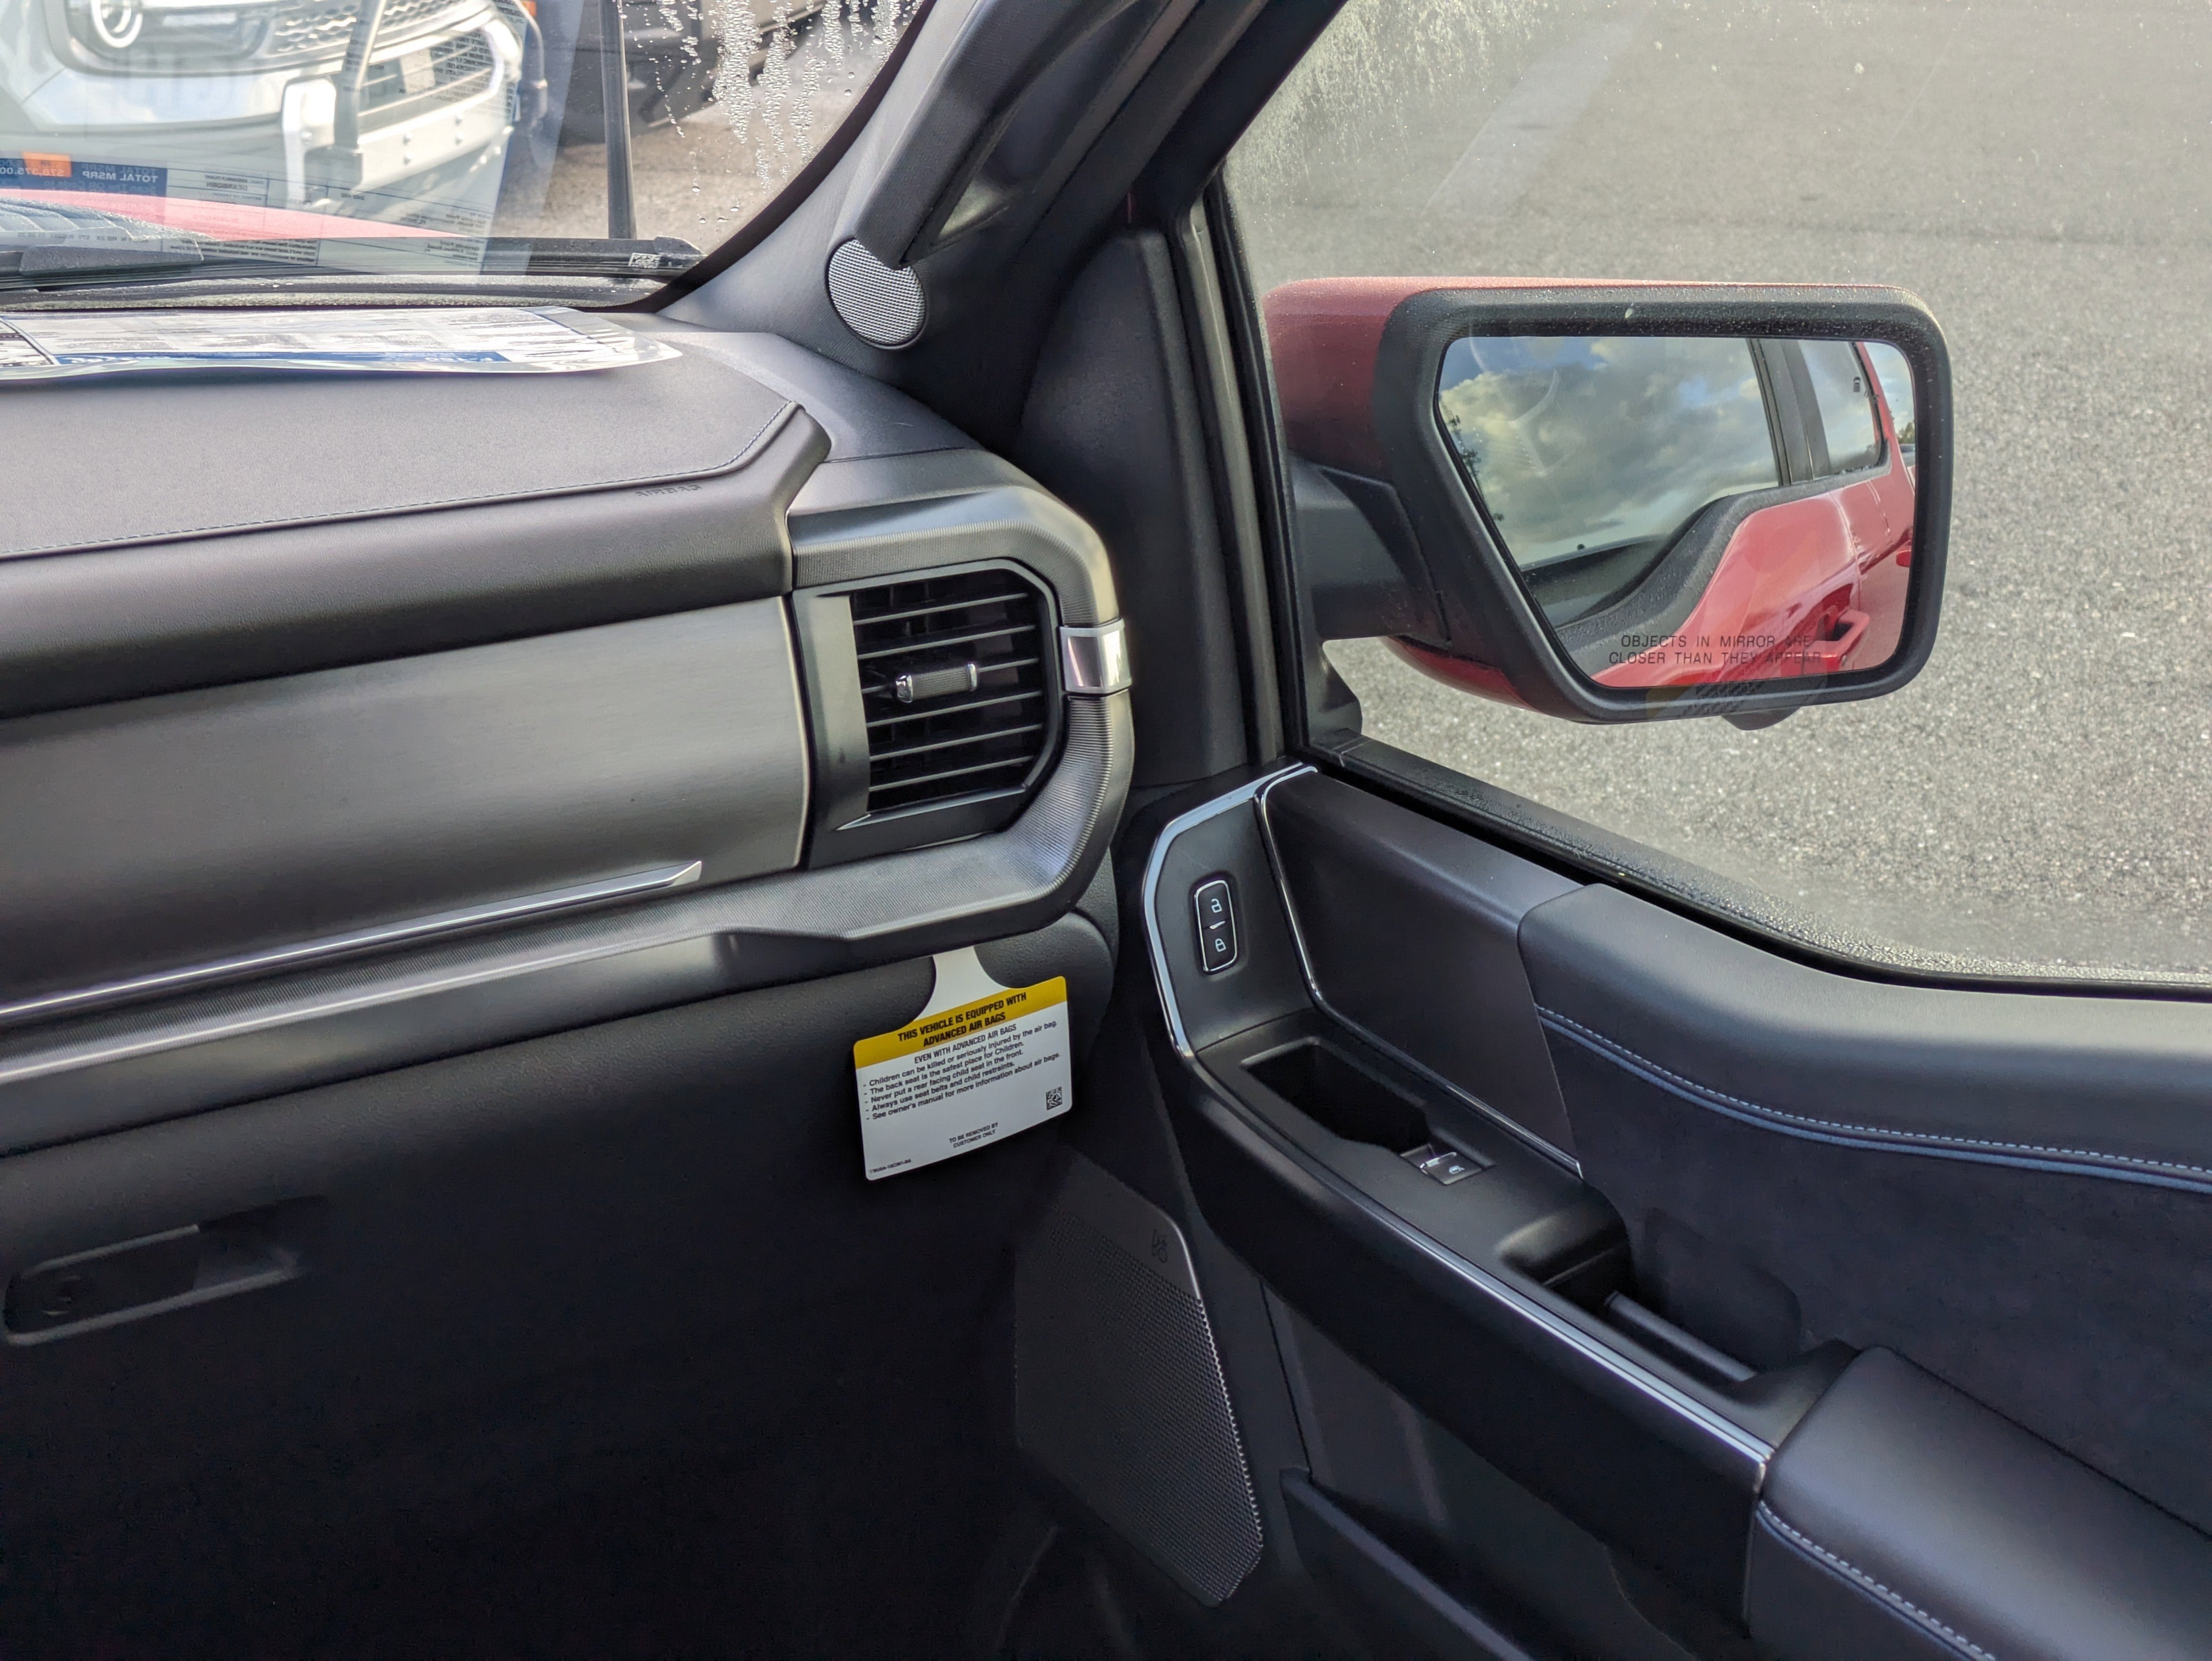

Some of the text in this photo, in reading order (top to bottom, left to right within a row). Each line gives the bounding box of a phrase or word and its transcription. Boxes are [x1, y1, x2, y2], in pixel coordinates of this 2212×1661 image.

[636, 485, 702, 496] AIRBAG
[1609, 651, 1821, 664] CLOSER THAN THEY APPEAR
[1621, 635, 1811, 647] OBJECTS IN MIRROR ARE
[897, 993, 1026, 1041] THIS VEHICLE IS EQUIPPED WITH
[923, 1012, 1005, 1046] ADVANCED AIR BAGS
[915, 1024, 1016, 1063] EVEN WITH ADVANCED AIR BAGS
[869, 1074, 899, 1087] Children
[902, 1069, 914, 1077] can
[927, 1058, 945, 1069] killed
[956, 1046, 986, 1060] seriously
[870, 1086, 883, 1095] The
[885, 1080, 902, 1090] back
[905, 1074, 918, 1084] seat
[942, 1061, 962, 1073] safest
[965, 1056, 982, 1066] place
[871, 1093, 892, 1103] Never
[894, 1087, 905, 1097] put
[914, 1082, 927, 1090] rear
[929, 1074, 951, 1085] facing
[952, 1067, 969, 1078] child
[971, 1062, 984, 1072] seat
[872, 1111, 886, 1120] See
[918, 1092, 943, 1106] manual
[956, 1083, 973, 1093] more
[1015, 1062, 1032, 1073] about
[872, 1099, 897, 1112] Always
[900, 1095, 912, 1103] use
[915, 1088, 929, 1098] seat
[931, 1084, 947, 1094] belts
[950, 1078, 962, 1087] and
[964, 1072, 980, 1083] child
